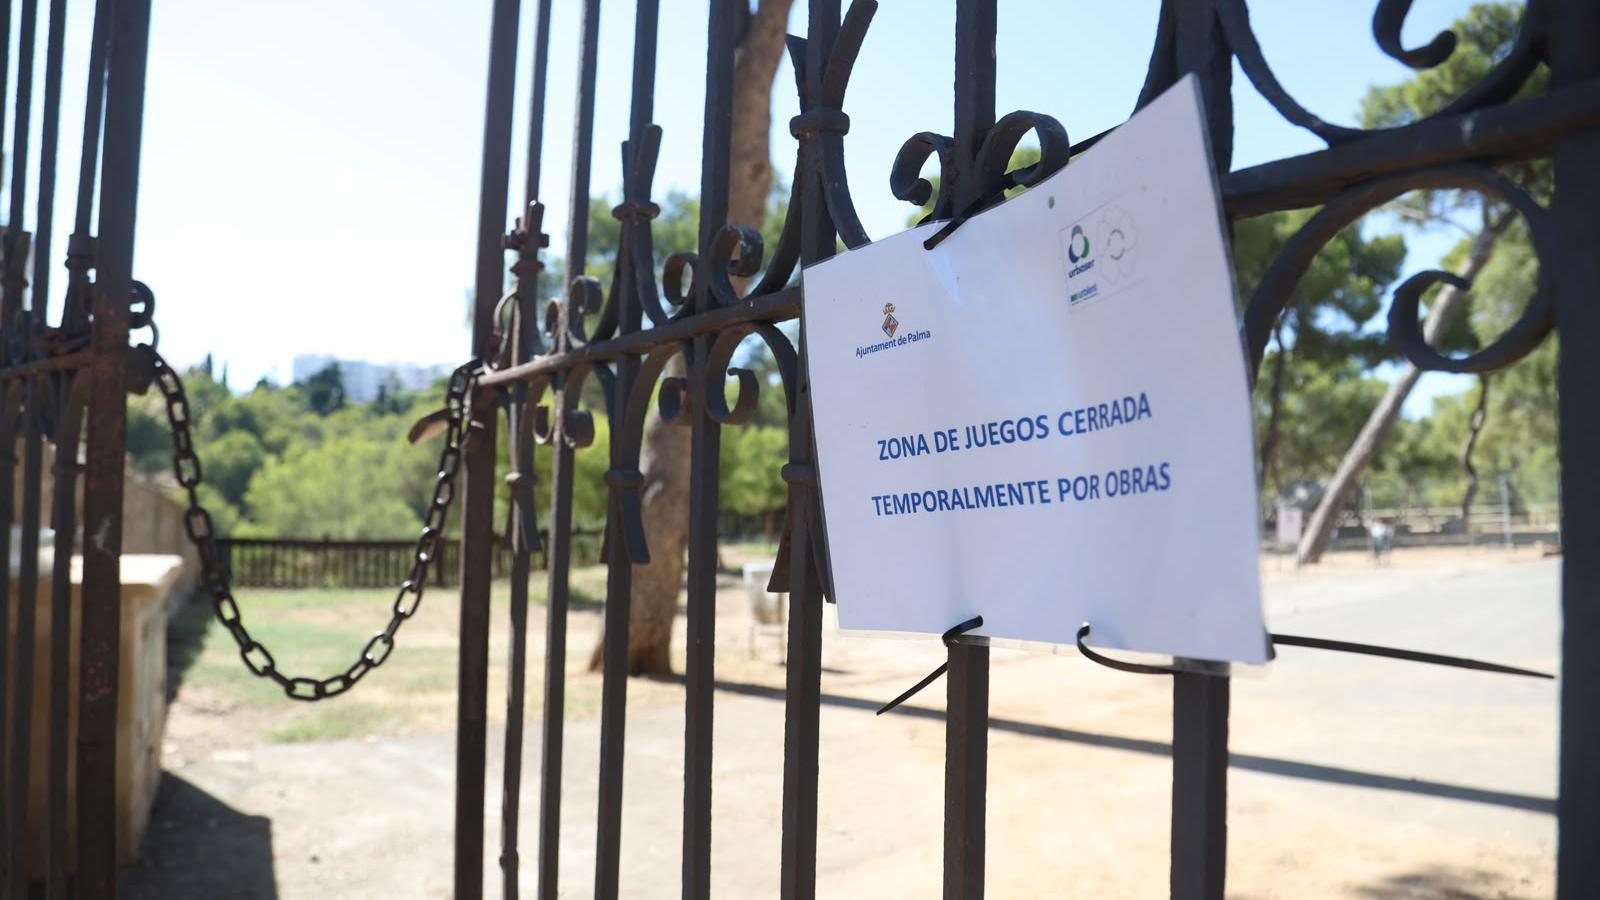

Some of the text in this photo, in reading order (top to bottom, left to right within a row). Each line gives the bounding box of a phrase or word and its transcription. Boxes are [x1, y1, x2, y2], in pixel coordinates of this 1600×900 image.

[856, 330, 931, 358] Ajuntament de Palma
[877, 392, 1152, 461] ZONA DE JUEGOS CERRADA
[871, 462, 1171, 516] TEMPORALMENTE POR OBRAS
